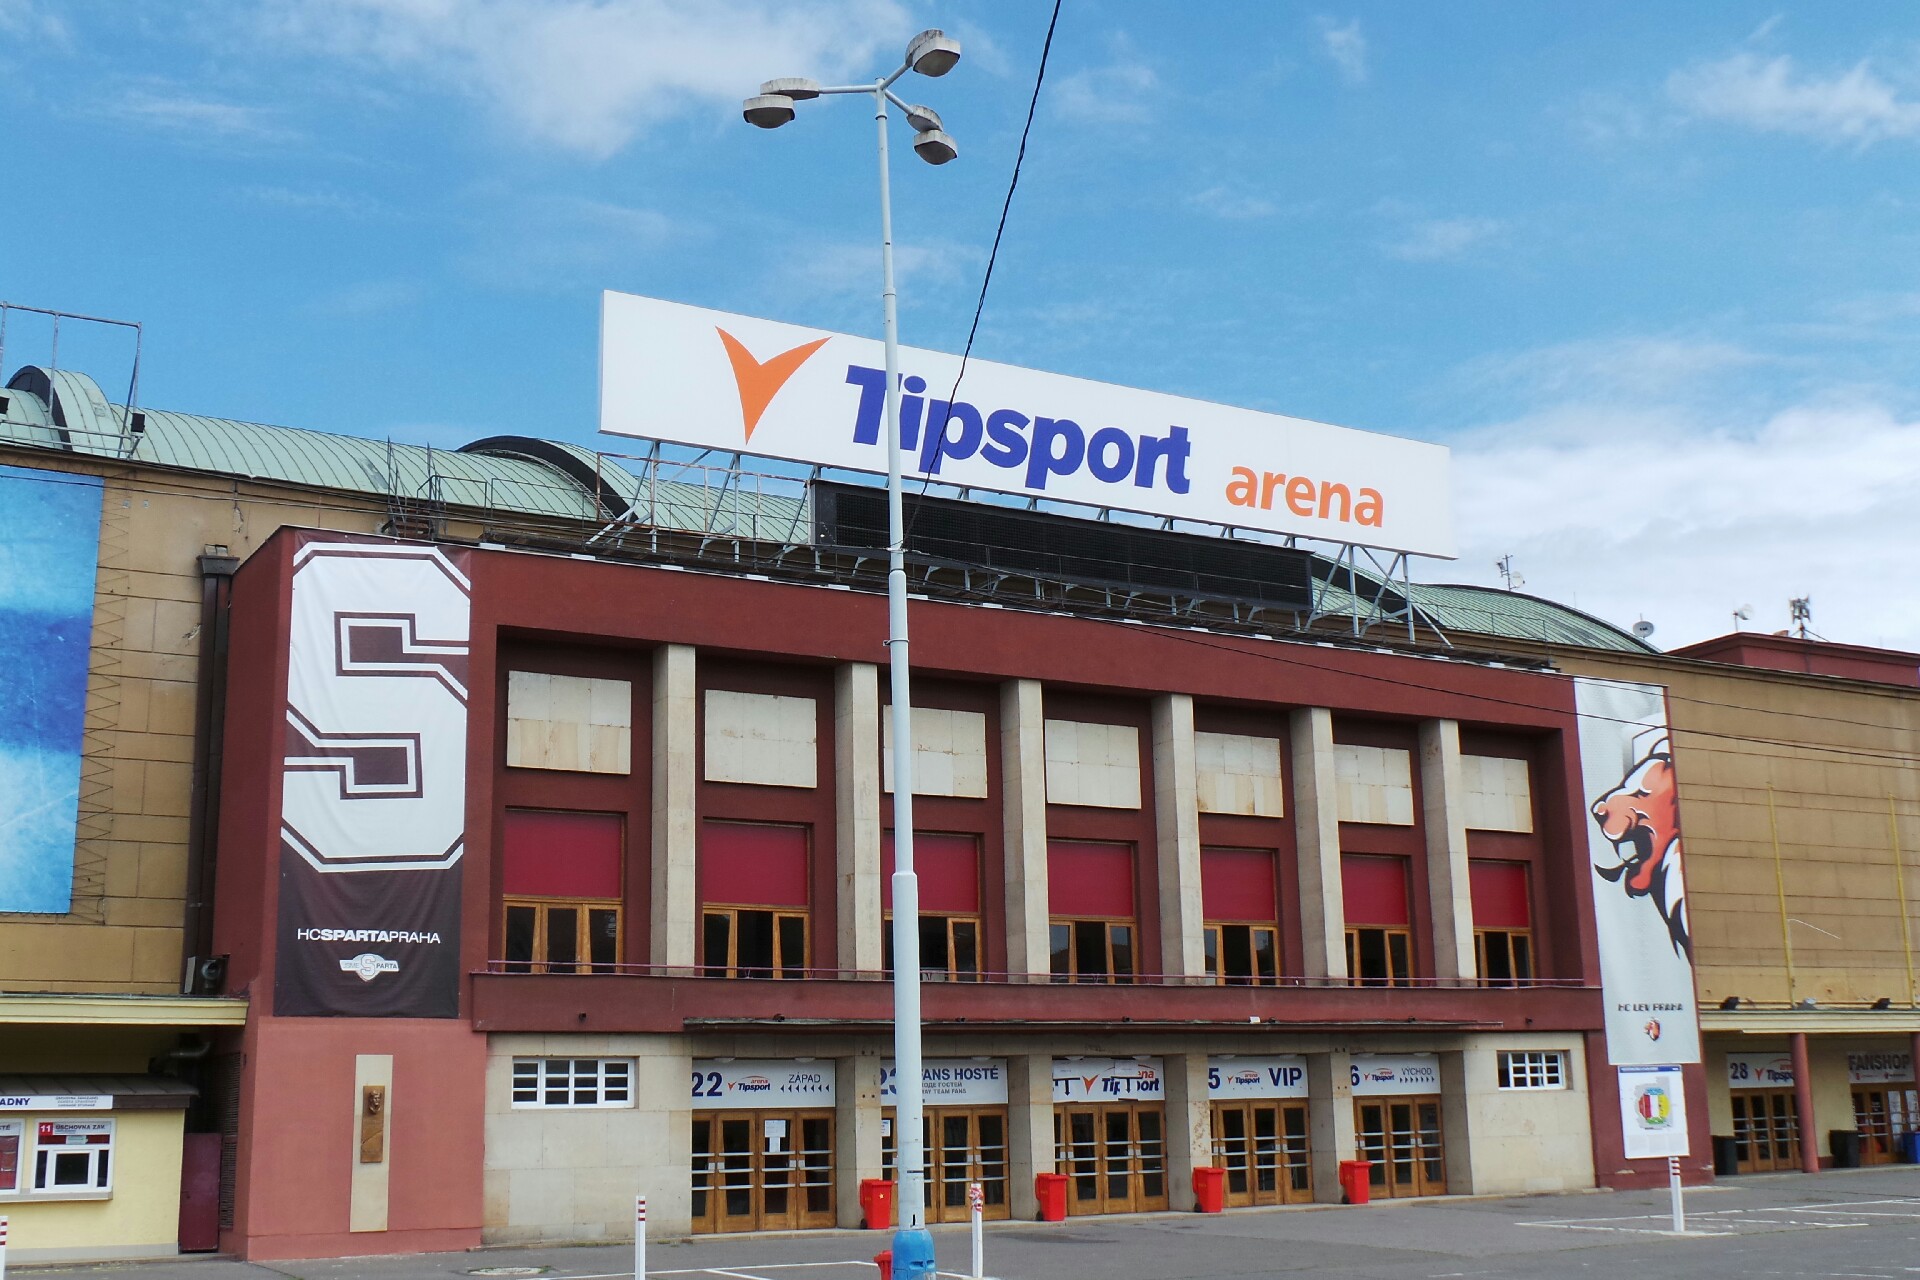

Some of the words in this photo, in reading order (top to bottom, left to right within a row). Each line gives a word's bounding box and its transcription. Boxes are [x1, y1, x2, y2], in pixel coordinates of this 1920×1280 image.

[848, 366, 1190, 494] Tipsport
[1226, 467, 1383, 527] arena
[1848, 1054, 1911, 1071] FANSHOP
[788, 1072, 822, 1084] ZÁPAD
[921, 1067, 951, 1081] ANS
[954, 1065, 999, 1081] HOSTÉ
[1267, 1067, 1303, 1087] VIP
[1371, 1074, 1395, 1082] Tipsport
[1729, 1062, 1749, 1081] 28
[692, 1072, 723, 1097] 22
[737, 1082, 771, 1093] Tipsport
[1235, 1076, 1260, 1086] Tipsport
[40, 1124, 51, 1133] 11
